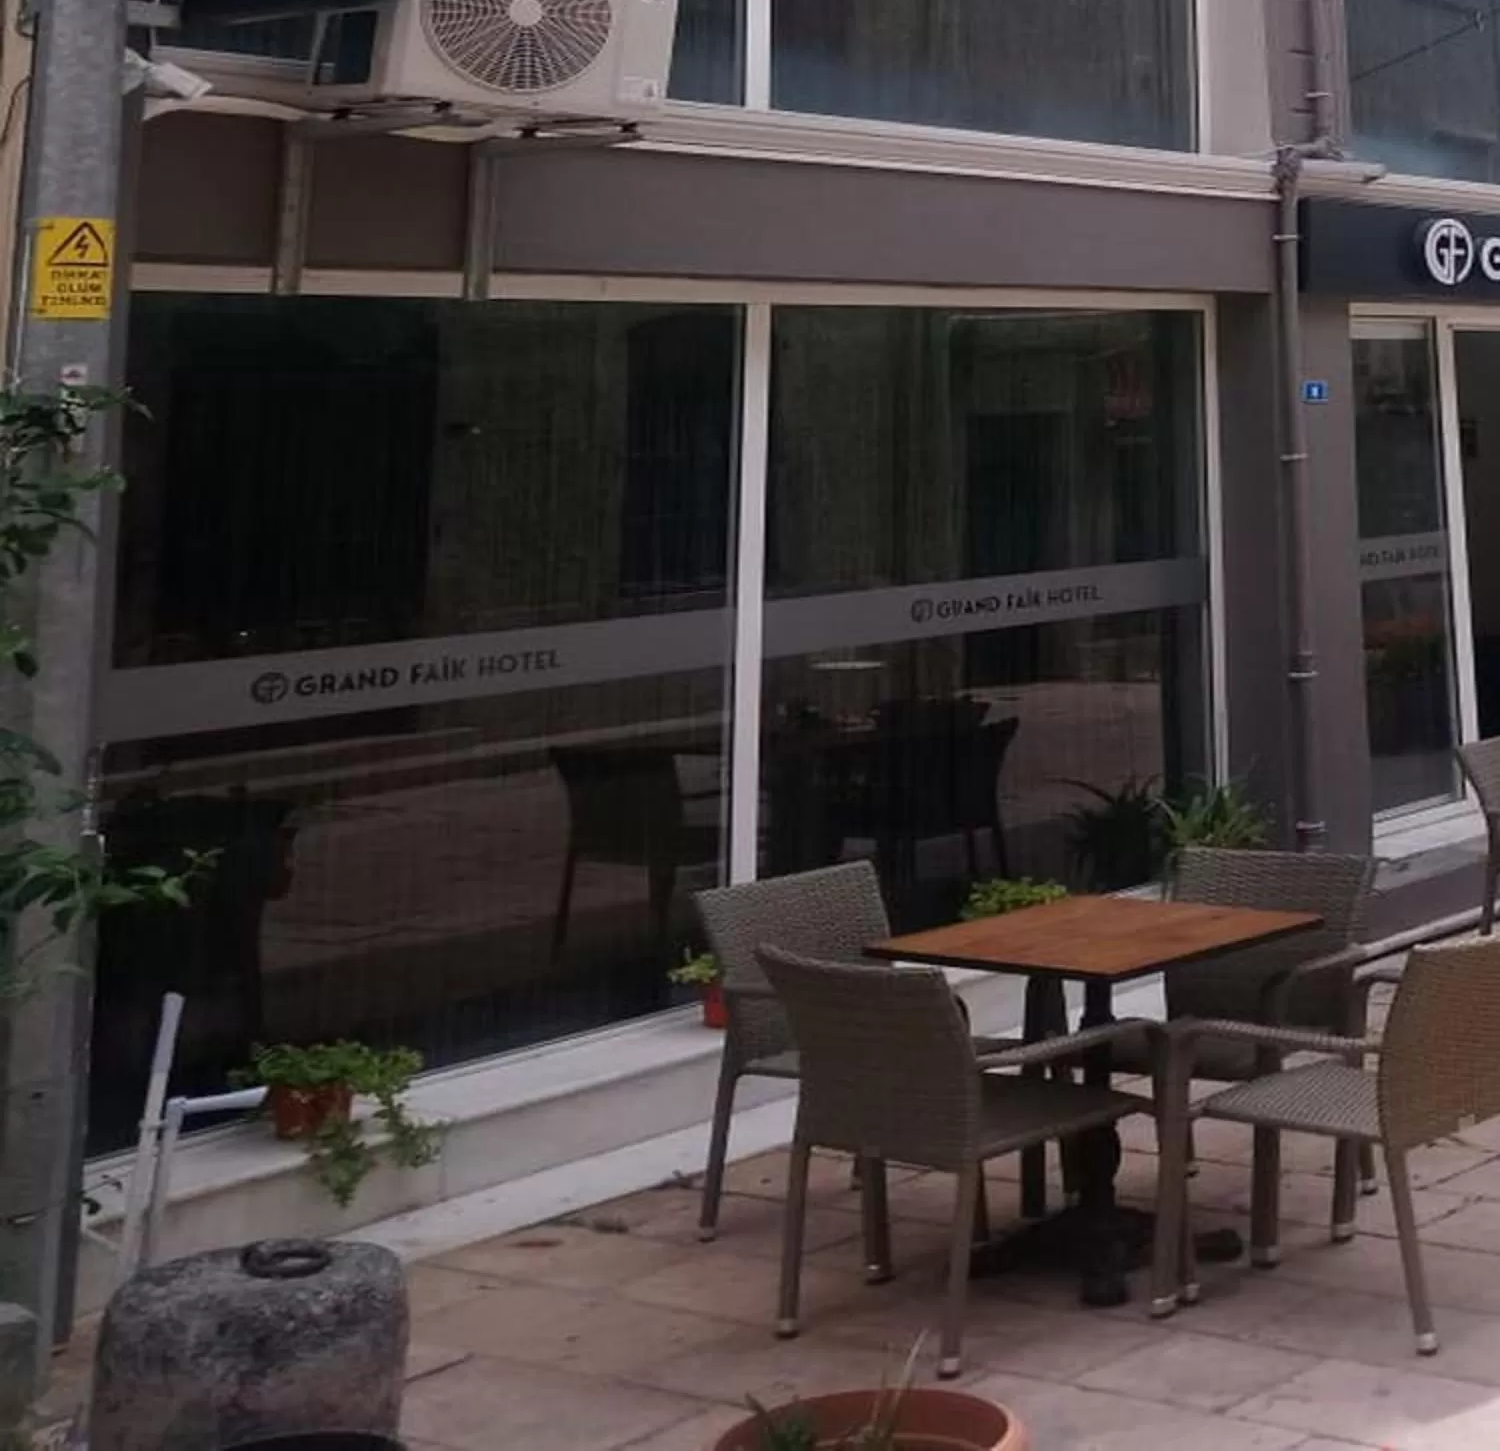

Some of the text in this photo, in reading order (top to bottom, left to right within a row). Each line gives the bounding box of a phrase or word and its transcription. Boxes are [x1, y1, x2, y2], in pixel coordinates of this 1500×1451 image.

[294, 667, 399, 696] GRAND
[410, 654, 469, 685] FAİK
[477, 649, 561, 678] HOTEL
